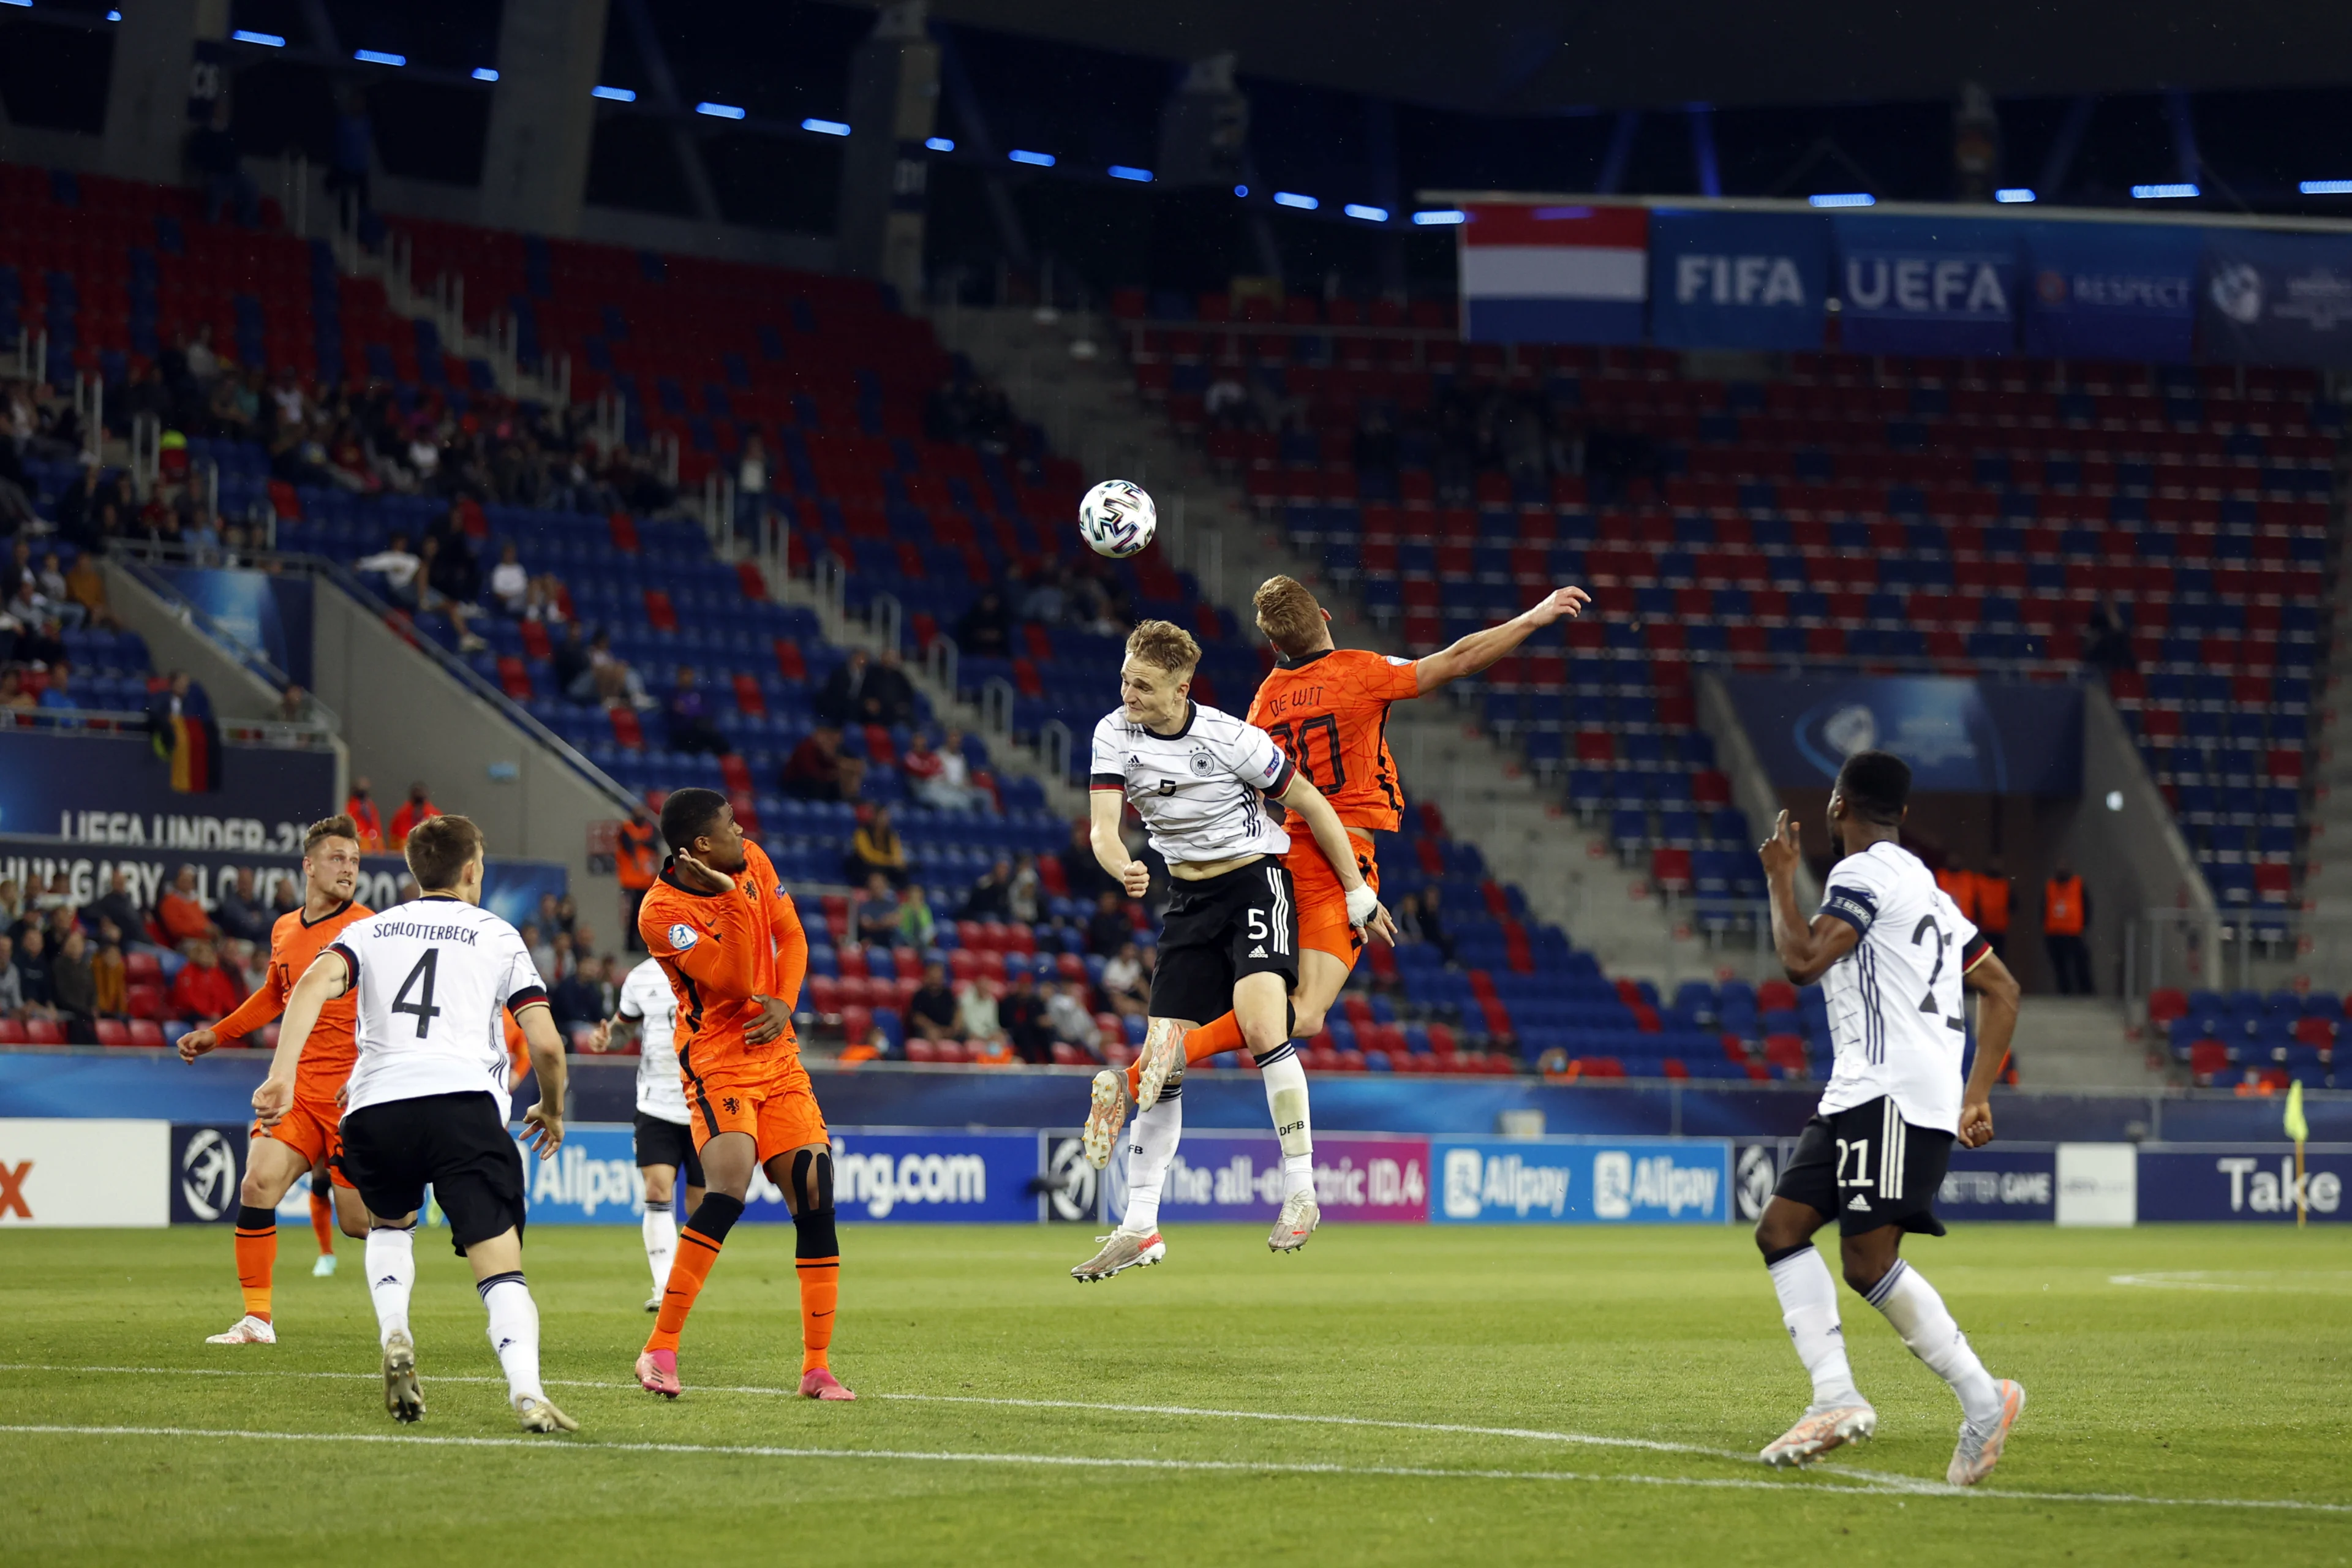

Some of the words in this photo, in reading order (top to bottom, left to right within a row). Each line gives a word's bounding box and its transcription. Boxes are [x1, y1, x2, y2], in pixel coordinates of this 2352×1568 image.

[1675, 255, 1803, 305] FIFA
[1847, 258, 2007, 312] UEFA
[1270, 694, 1287, 717] DE
[1292, 687, 1324, 706] WIT
[373, 921, 480, 946] SCHLOTTERBECK
[1247, 908, 1268, 940] 5
[391, 948, 440, 1039] 4
[1128, 1144, 1144, 1155] FB
[1279, 1120, 1305, 1136] DFB
[532, 1144, 644, 1216] Alipay
[1215, 1154, 1366, 1207] all-eltric
[1482, 1153, 1571, 1218] Alipay
[1632, 1155, 1719, 1218] Alipay
[1835, 1138, 1874, 1187] 21
[2216, 1155, 2342, 1213] Take
